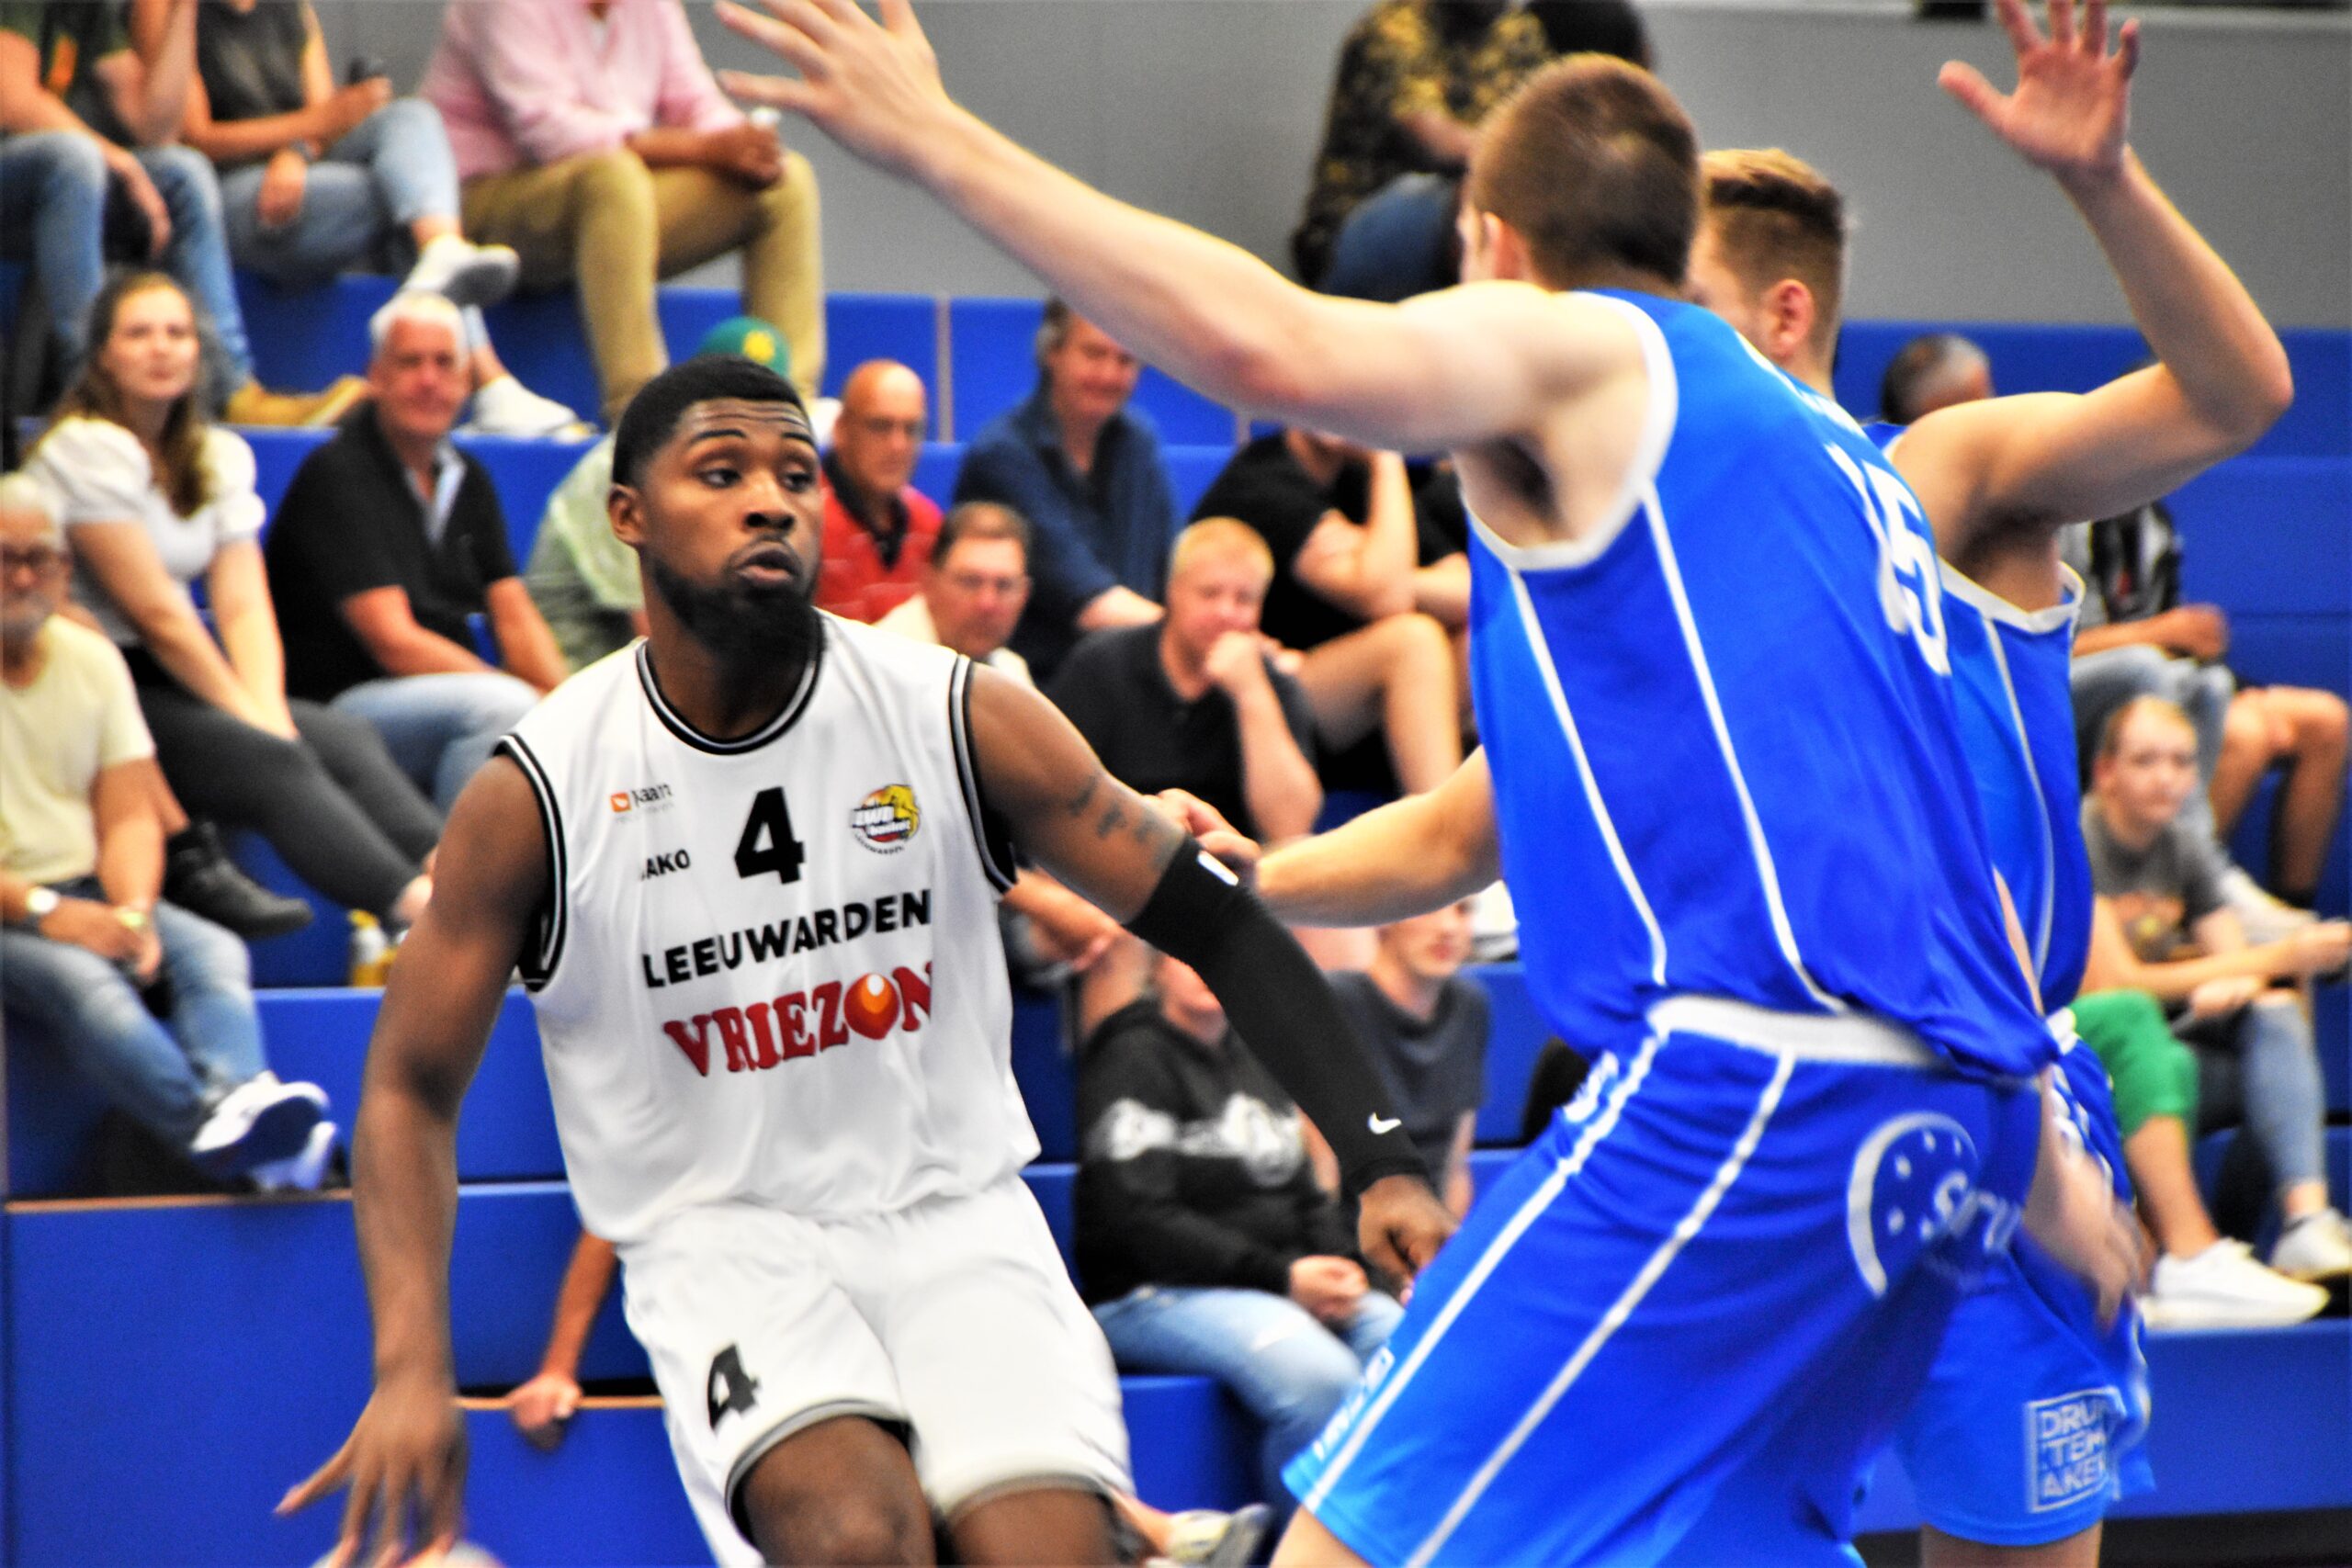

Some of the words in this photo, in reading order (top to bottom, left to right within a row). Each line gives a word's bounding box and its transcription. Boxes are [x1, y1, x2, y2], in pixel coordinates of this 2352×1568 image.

[640, 848, 691, 882] AKO
[734, 785, 806, 885] 4
[643, 888, 932, 988] LEEUWARDEN
[663, 960, 933, 1077] VRIEZON
[707, 1342, 759, 1433] 4
